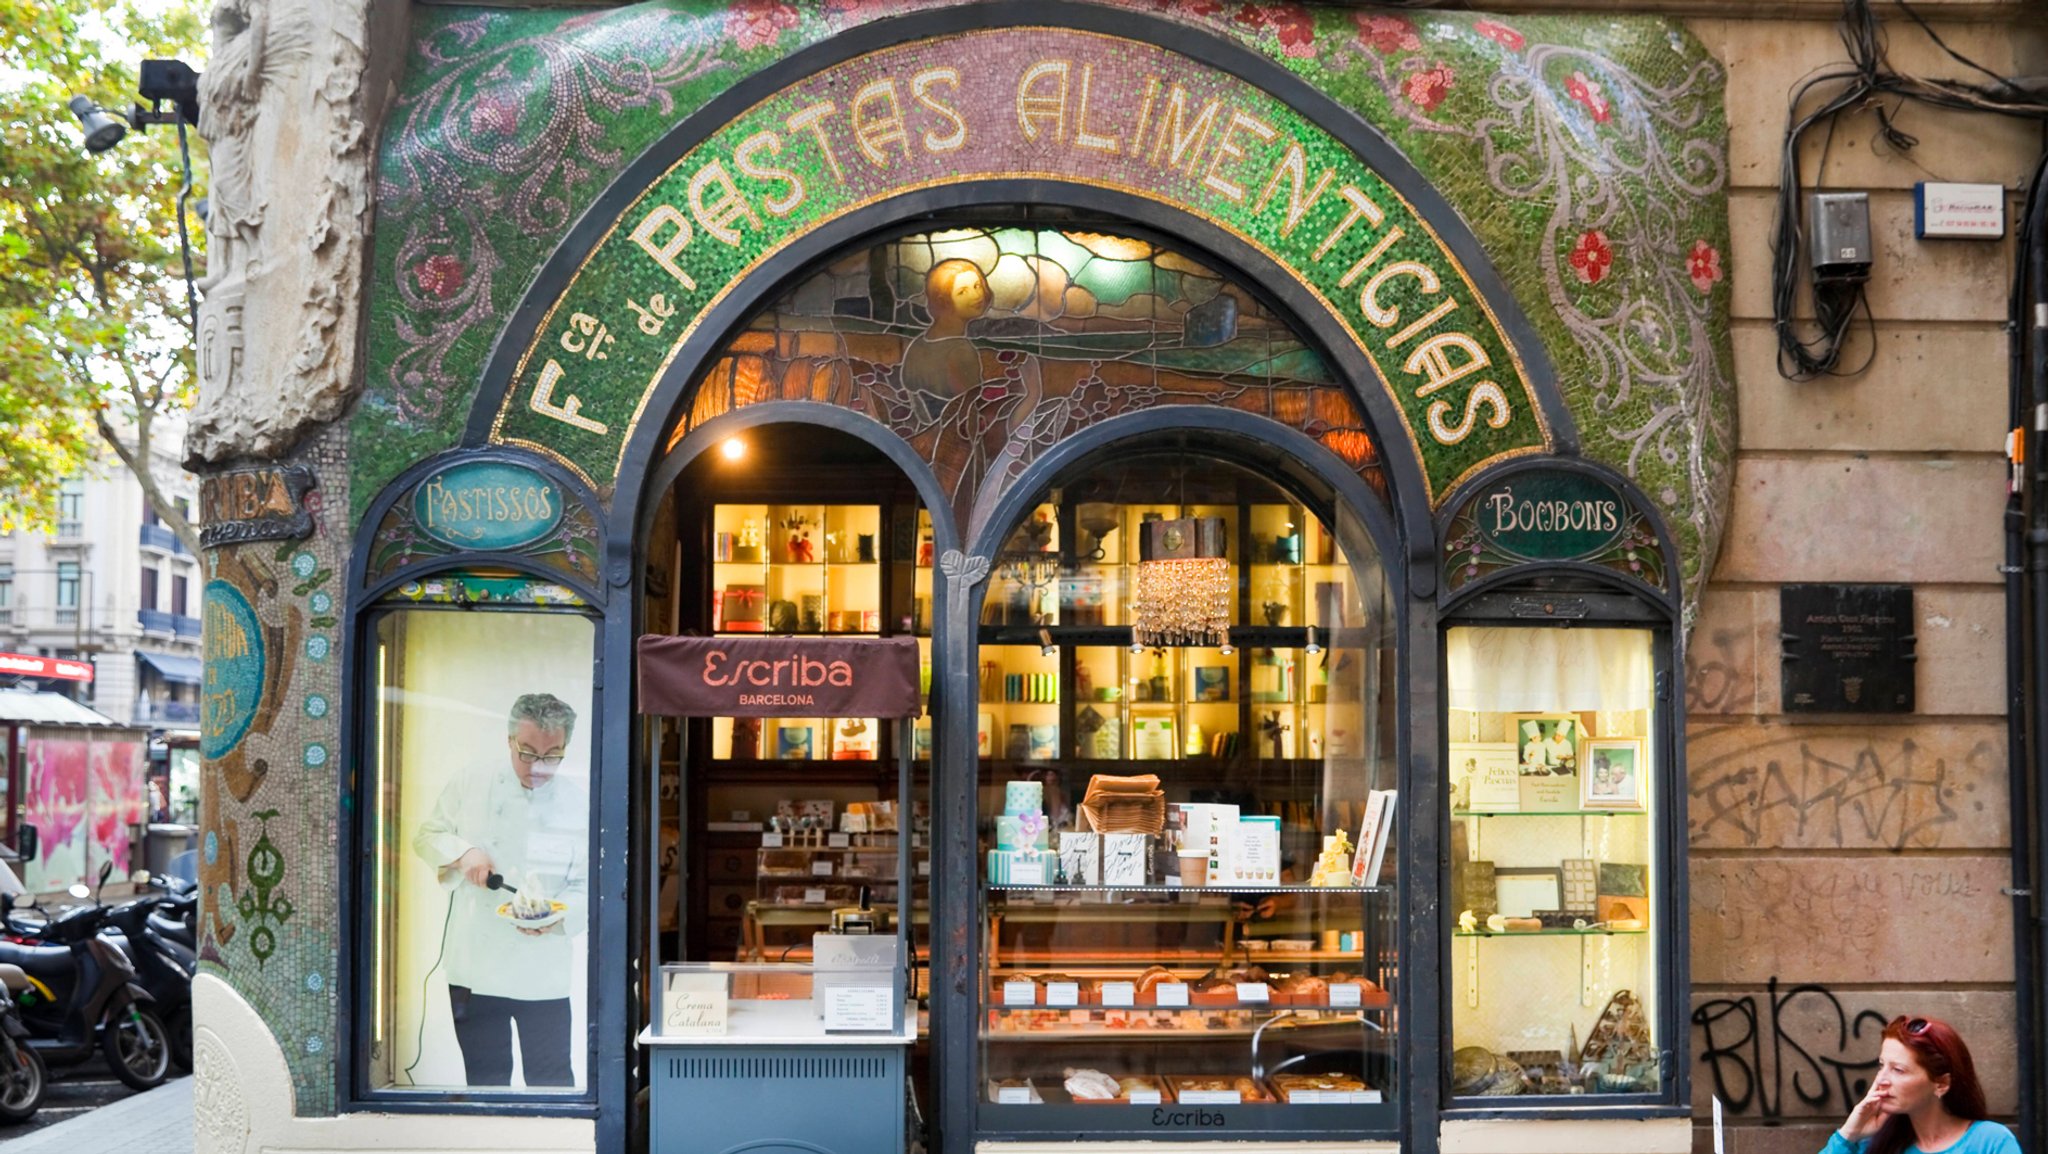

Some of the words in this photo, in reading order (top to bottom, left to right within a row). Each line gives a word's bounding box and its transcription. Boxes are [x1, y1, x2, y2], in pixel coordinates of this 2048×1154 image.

[627, 66, 967, 291] PASTAS
[1016, 59, 1510, 446] ALIMENTICIAS
[627, 293, 676, 336] de
[1485, 486, 1618, 537] BOMBONS
[739, 694, 815, 706] BARCELONA
[668, 1010, 721, 1027] Catalana
[676, 993, 713, 1010] Crema
